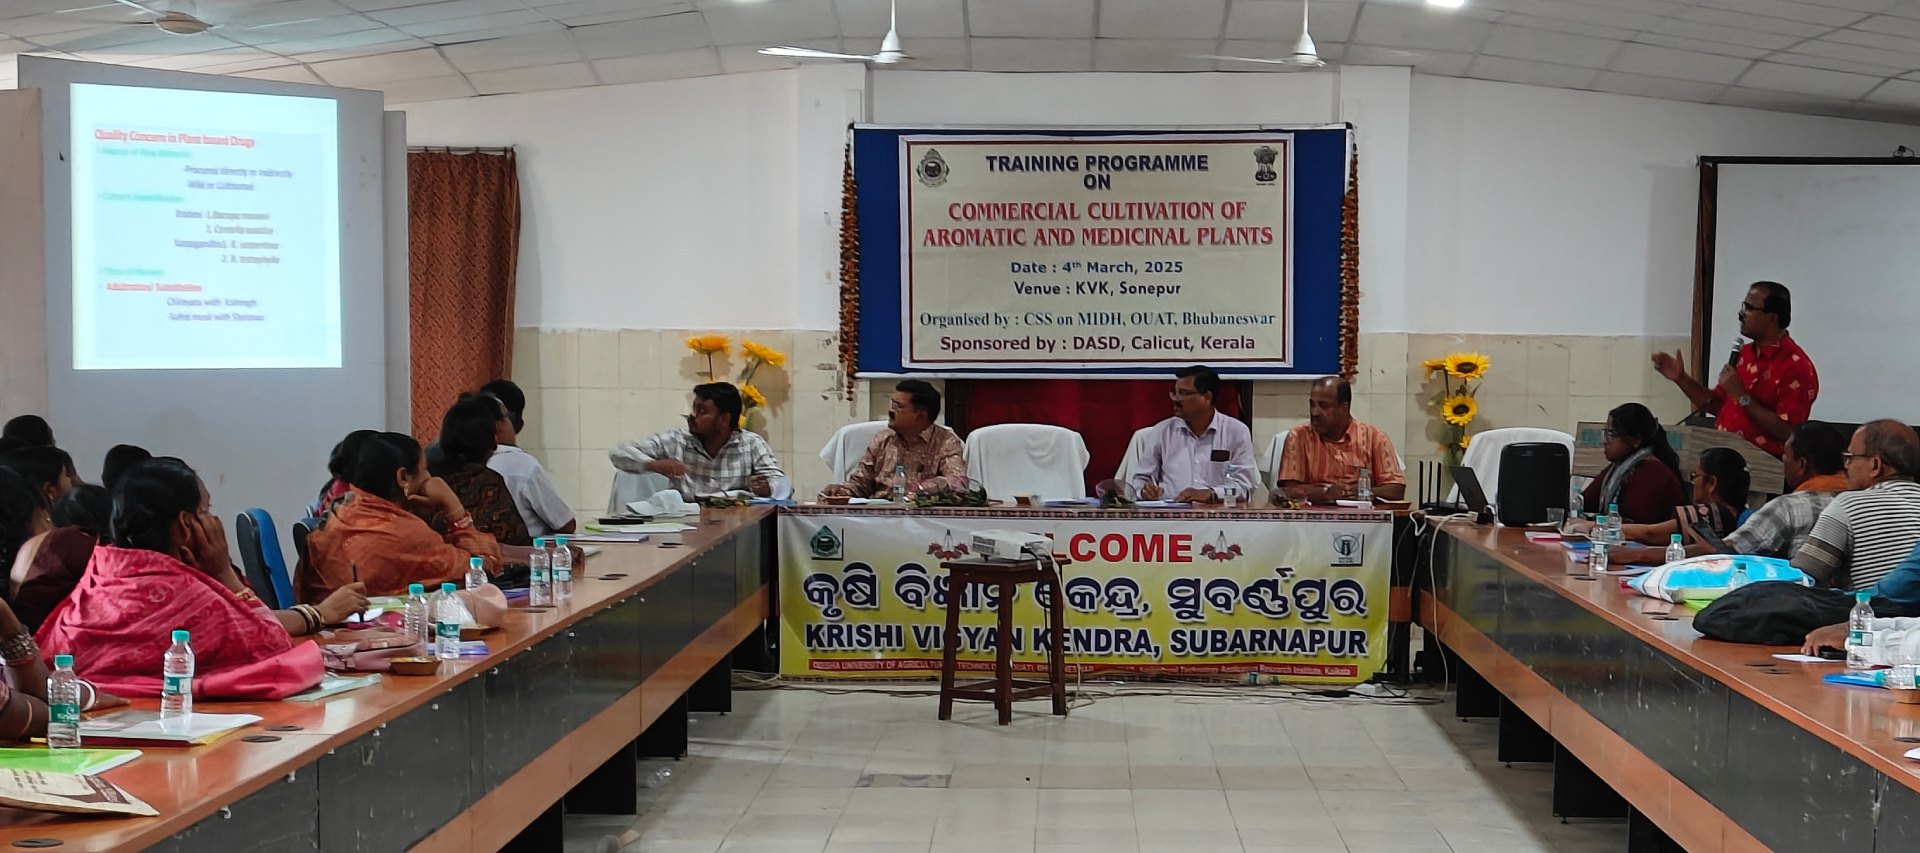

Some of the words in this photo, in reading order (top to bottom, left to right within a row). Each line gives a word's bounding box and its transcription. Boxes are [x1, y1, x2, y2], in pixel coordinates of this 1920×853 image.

[986, 155, 1079, 171] TRAINING
[1086, 155, 1208, 171] PROGRAMME
[1084, 174, 1111, 190] ON
[948, 202, 1080, 221] COMMERCIAL
[1087, 202, 1214, 221] CULTIVATION
[1221, 201, 1247, 220] OF
[923, 228, 1027, 247] AROMATIC
[1034, 228, 1075, 246] AND
[1082, 227, 1190, 247] MEDICINAL
[1197, 226, 1273, 246] PLANTS
[1011, 261, 1047, 273] Date
[1062, 261, 1082, 273] 4th
[1087, 261, 1138, 275] March,
[1144, 261, 1183, 273] 2025
[1014, 281, 1061, 295] Venue
[1076, 281, 1114, 297] KVK,
[1119, 281, 1181, 297] Sonepur
[920, 312, 989, 329] Organised
[994, 312, 1010, 329] by
[1024, 312, 1053, 326] CSS
[1056, 316, 1073, 326] on
[1078, 312, 1126, 328] MIDH,
[1130, 312, 1177, 327] OUAT,
[1182, 311, 1276, 326] Bhubaneswar
[940, 336, 1030, 353] Sponsored
[1036, 336, 1056, 353] by
[1073, 336, 1125, 352] DASD,
[1131, 336, 1195, 352] Calicut,
[1201, 336, 1255, 350] Kerala
[1045, 533, 1192, 562] COME
[803, 562, 877, 618] କୃଷି
[806, 624, 903, 648] KRISHI
[1170, 629, 1366, 654] SUBARNAPUR
[842, 661, 884, 669] UNIVERSITY
[886, 660, 895, 669] OF
[898, 660, 943, 669] AGRICULTUR
